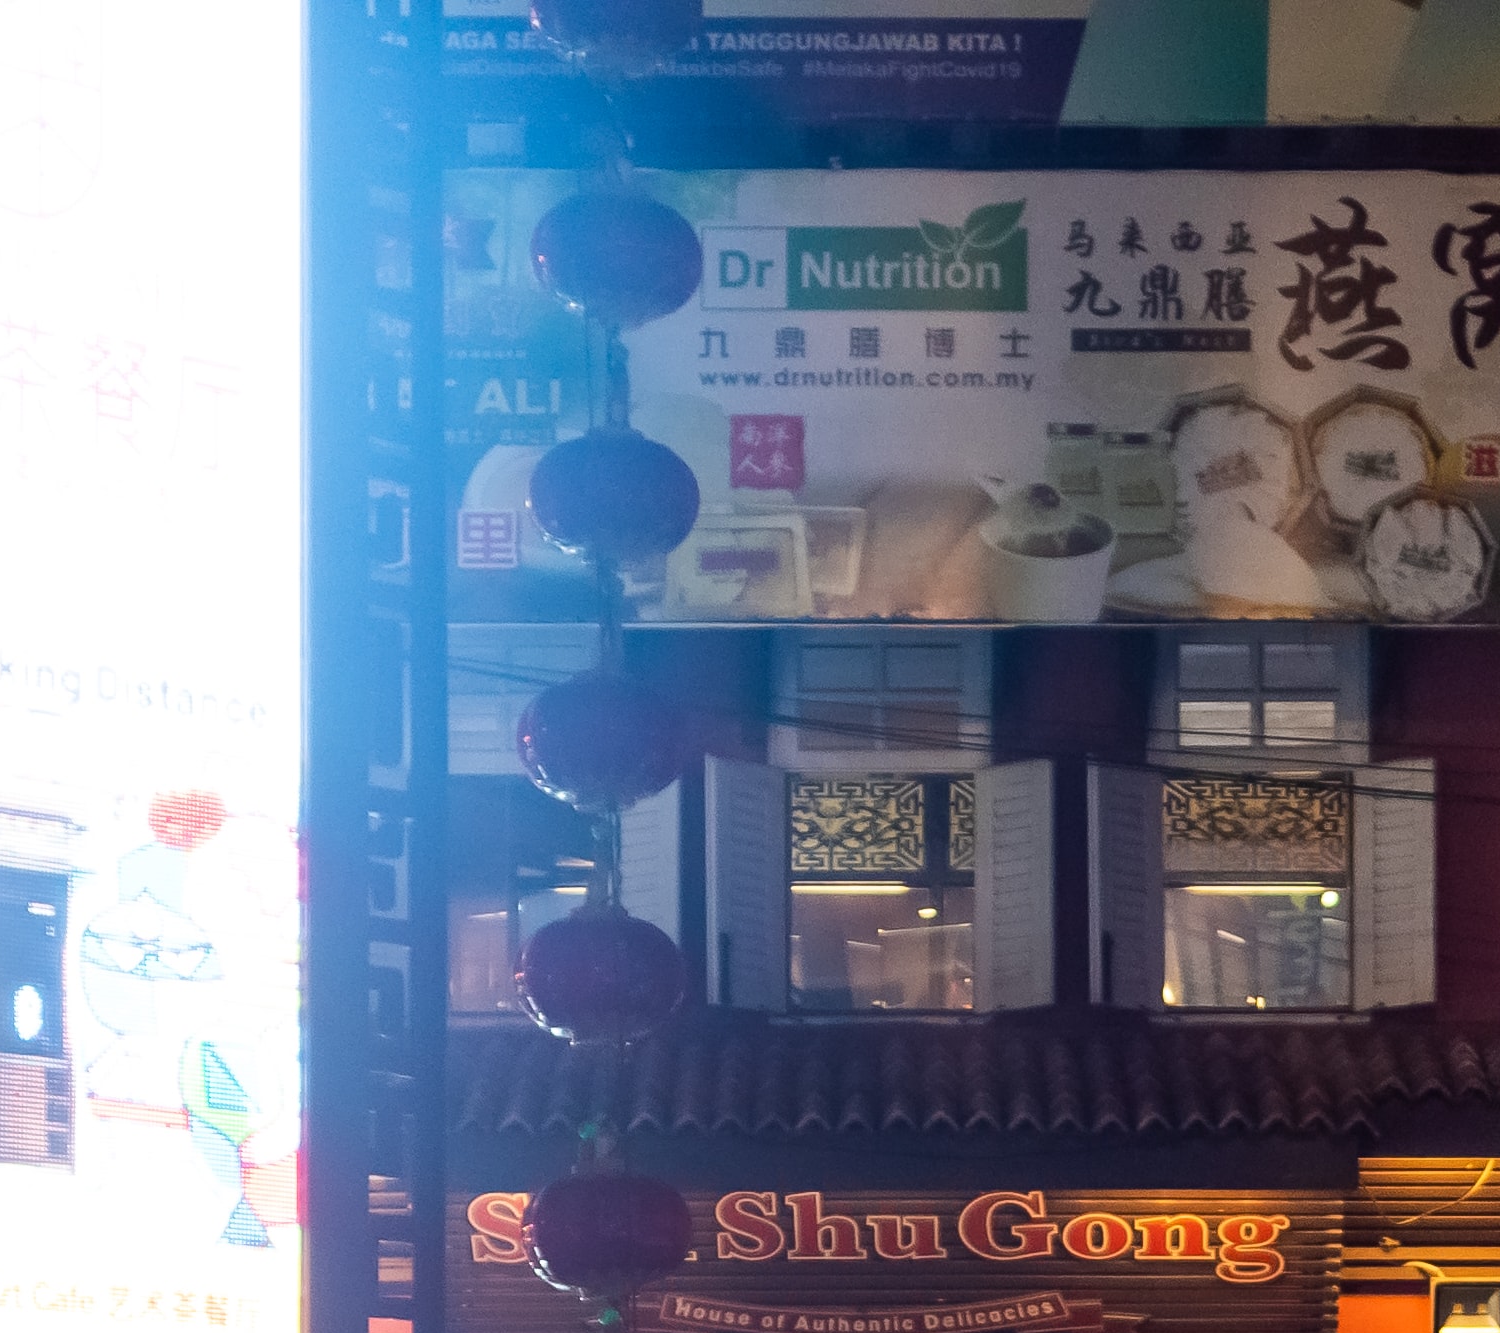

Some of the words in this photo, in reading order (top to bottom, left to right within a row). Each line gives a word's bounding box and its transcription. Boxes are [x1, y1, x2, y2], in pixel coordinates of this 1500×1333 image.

[707, 32, 940, 52] TANGGUNGJAWAB
[947, 33, 1006, 51] KITA
[718, 248, 773, 289] Dr
[799, 246, 1003, 292] Nutrition
[474, 378, 562, 416] ALI
[698, 366, 1036, 392] www.drnutrition.com.my
[96, 663, 268, 729] Distance
[715, 1189, 948, 1262] Shu
[956, 1188, 1292, 1285] Gong
[672, 1296, 753, 1329] House
[761, 1309, 786, 1331] of
[922, 1297, 1055, 1333] Delicacies
